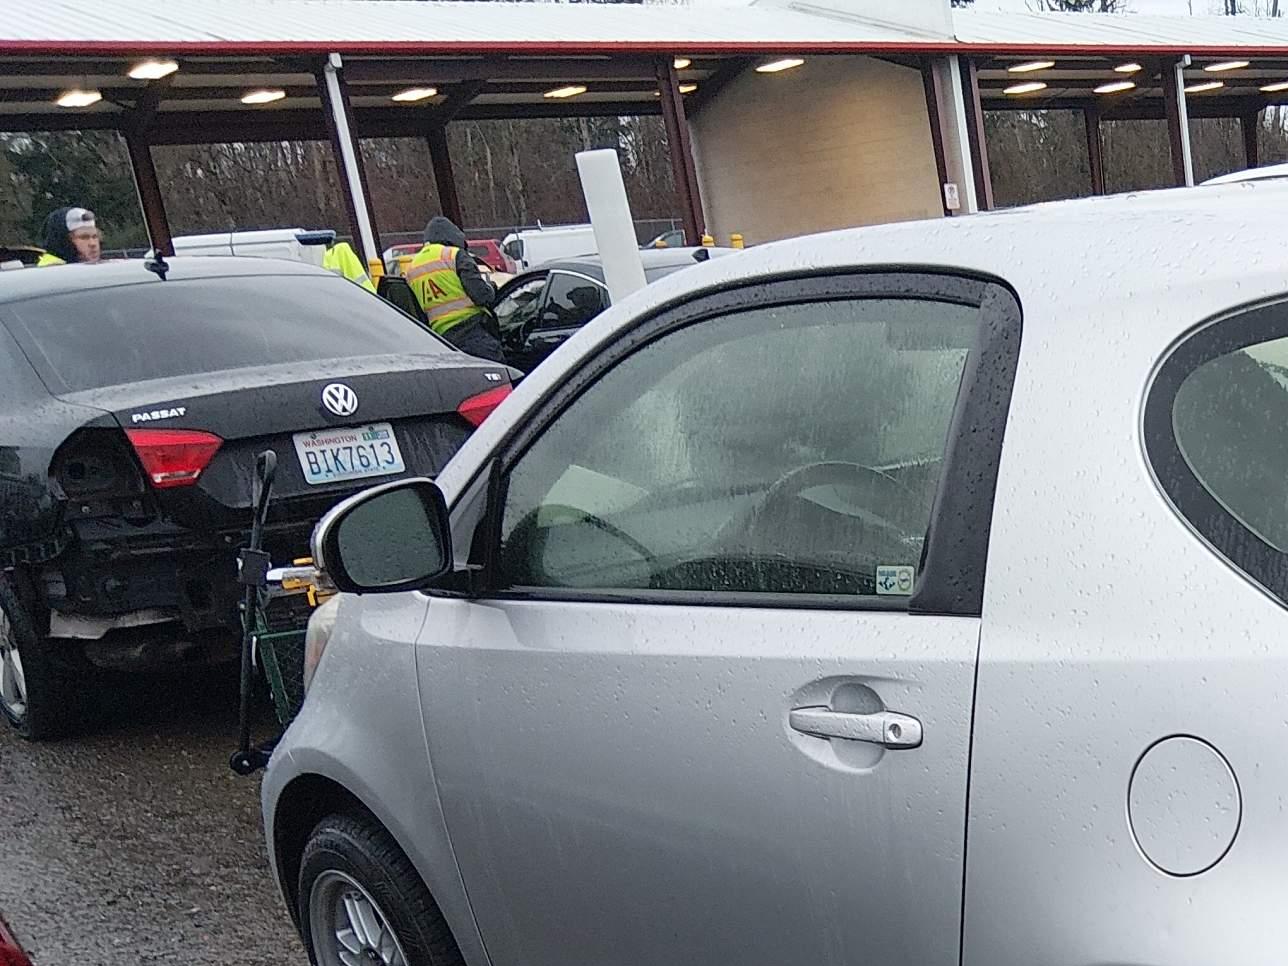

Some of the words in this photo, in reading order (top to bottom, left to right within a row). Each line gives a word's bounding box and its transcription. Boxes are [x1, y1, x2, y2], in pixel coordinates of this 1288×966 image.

[131, 407, 186, 423] PASSAT
[303, 434, 358, 449] WASHINGTON
[305, 441, 395, 476] BIK7613
